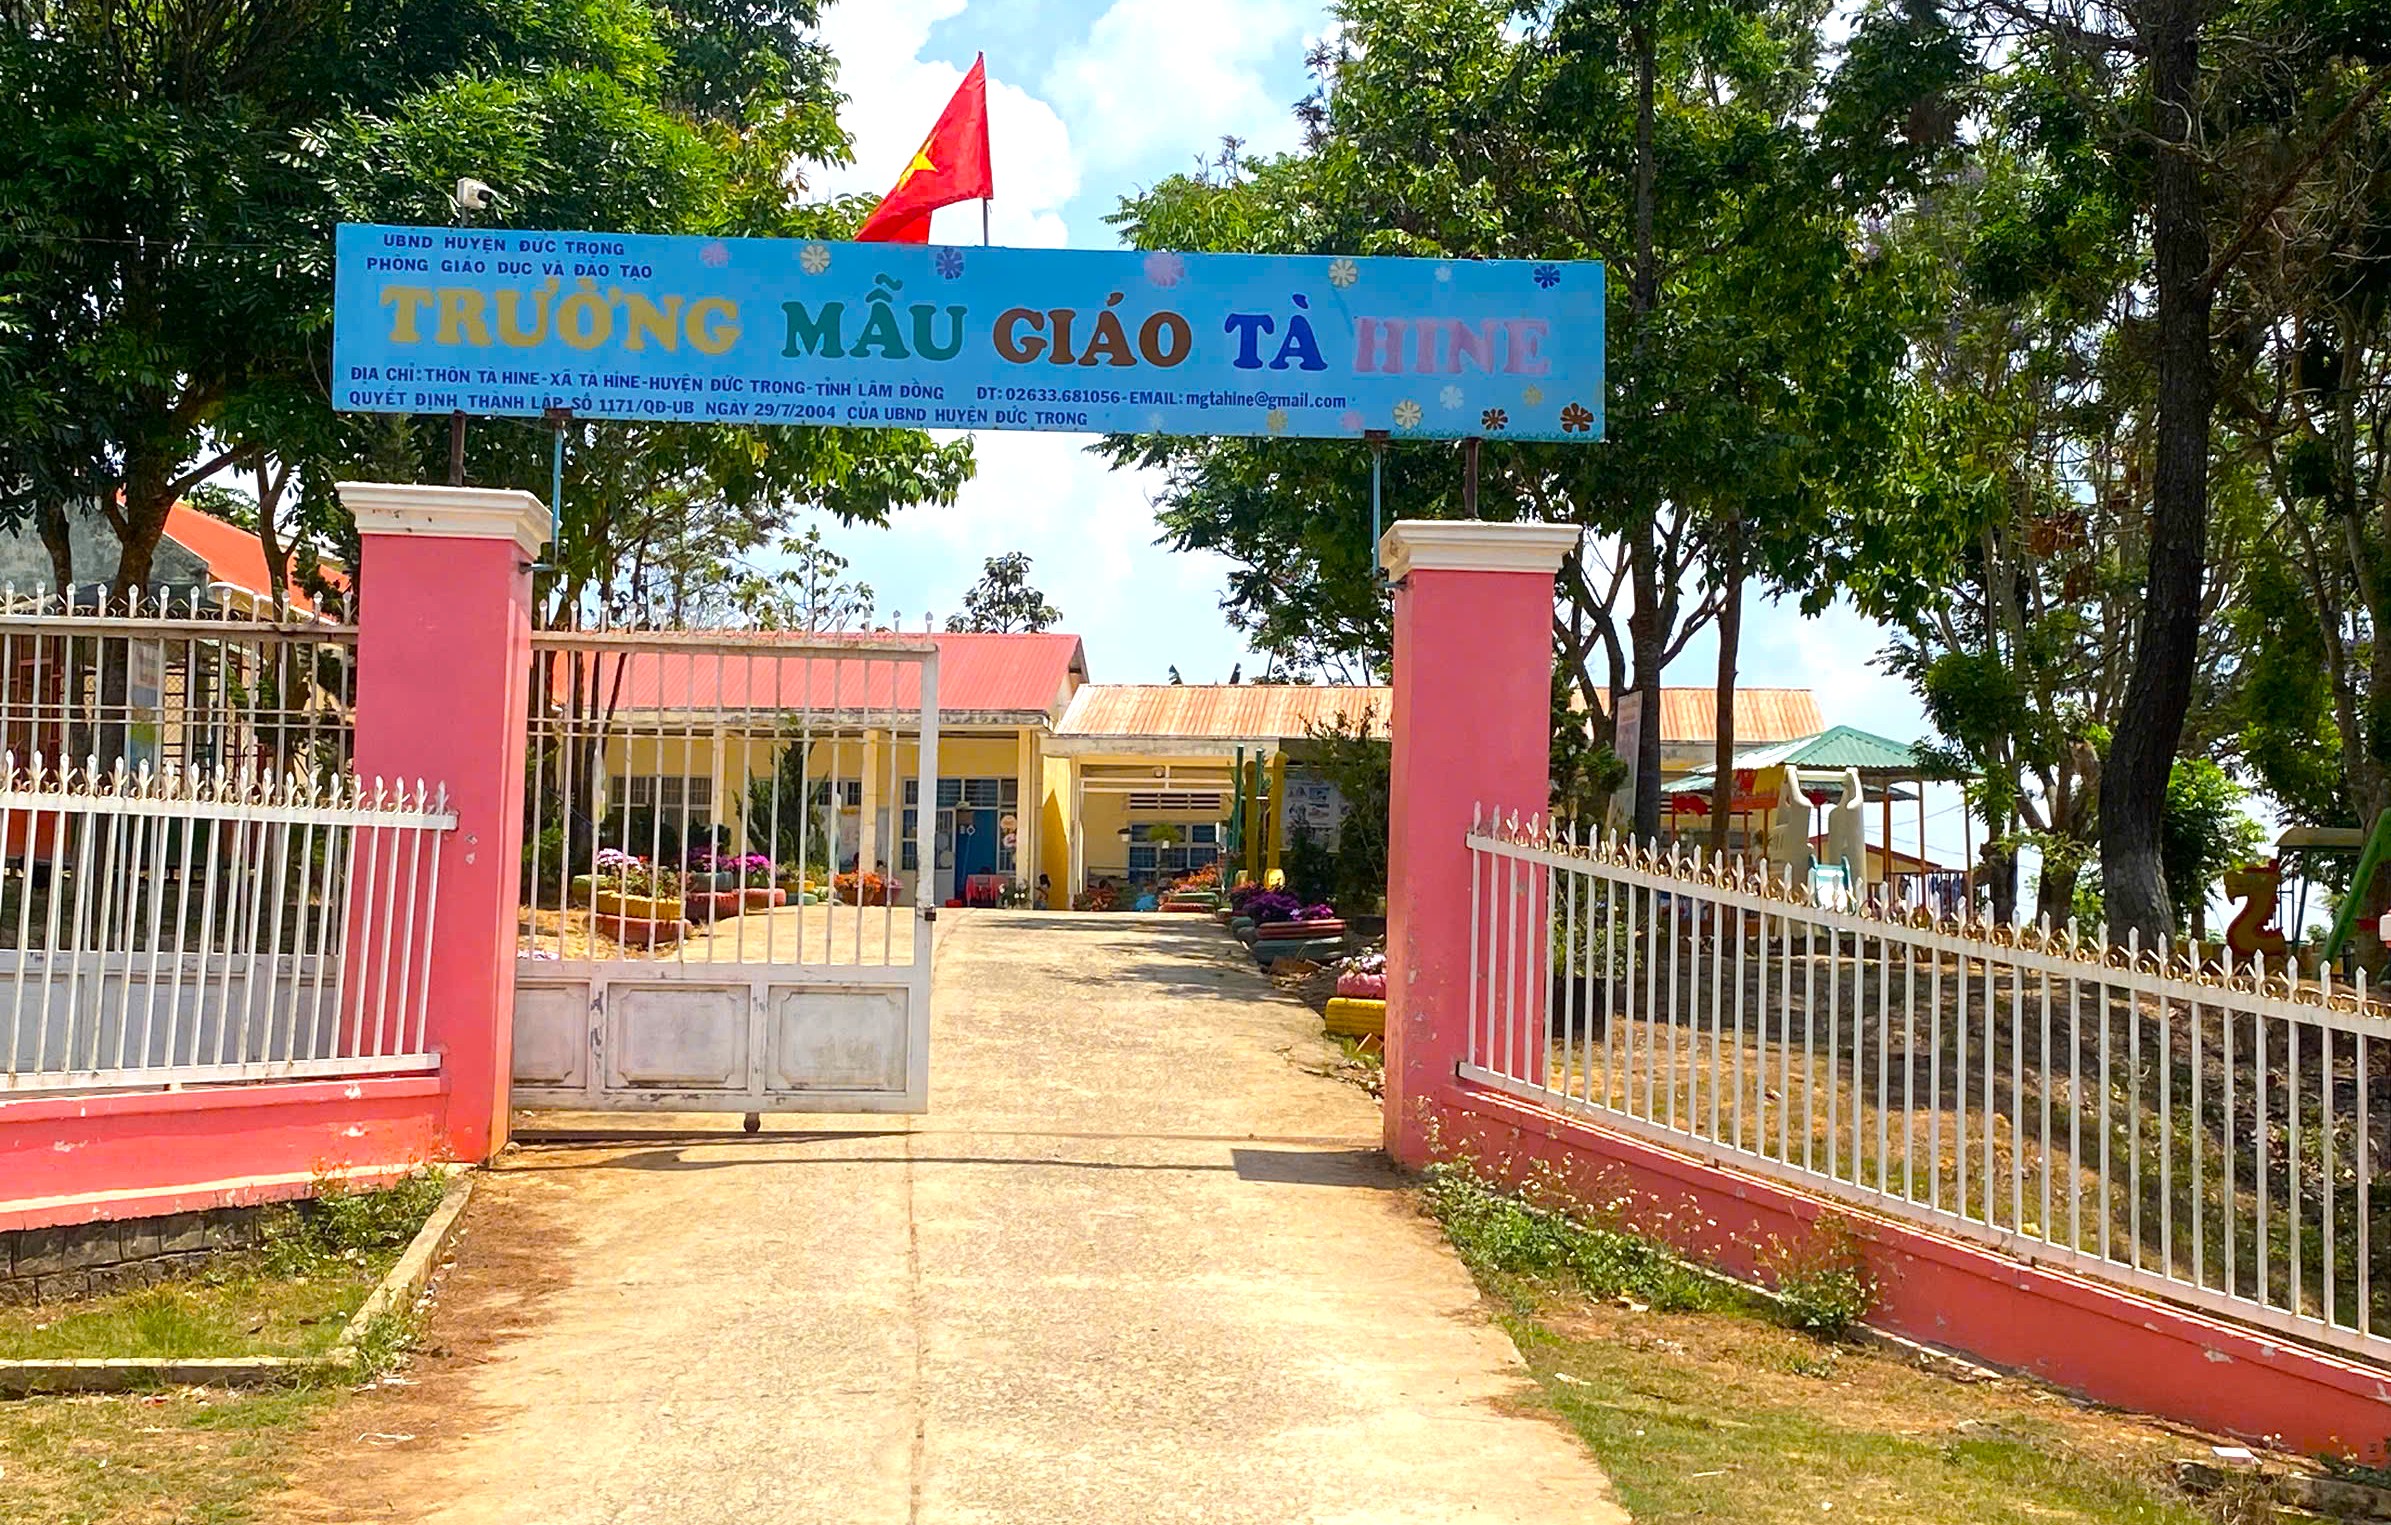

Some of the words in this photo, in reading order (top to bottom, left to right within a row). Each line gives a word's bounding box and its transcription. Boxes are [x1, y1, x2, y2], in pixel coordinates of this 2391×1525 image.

[367, 253, 428, 271] PHÒNG
[441, 255, 485, 273] GIÁO
[498, 261, 532, 279] DỤC
[542, 260, 564, 276] VÀ
[574, 260, 609, 276] ĐÀO
[620, 264, 652, 281] TẠO
[384, 234, 433, 249] UBND
[445, 235, 506, 254] HUYỆN
[520, 236, 556, 253] ĐỨC
[565, 241, 624, 258] TRỌNG
[380, 277, 742, 356] TRƯỜNG
[780, 273, 967, 361] MẪU
[993, 292, 1192, 368] GIÁO
[1224, 293, 1328, 371] TÀ
[1353, 316, 1550, 375] HINE
[349, 385, 406, 406] QUYẾT
[415, 392, 457, 410] ĐỊNH
[468, 390, 524, 409] THÀNH
[571, 392, 592, 411] SỐ
[706, 398, 749, 416] NGÀY
[754, 402, 836, 419] 29/7/2004
[847, 400, 879, 420] CỦA
[884, 408, 926, 421] UBND
[935, 405, 988, 425] HUYỆN
[995, 405, 1027, 424] ĐỨC
[1035, 411, 1087, 428] TRỌNG
[351, 366, 379, 385] ĐỊA
[477, 366, 498, 383] TÀ
[579, 369, 599, 387] TÀ
[711, 374, 743, 392] ĐỨC
[858, 380, 892, 398] LÂM
[901, 377, 944, 400] ĐỒNG
[1186, 390, 1346, 410] mgtahine@gmail.com
